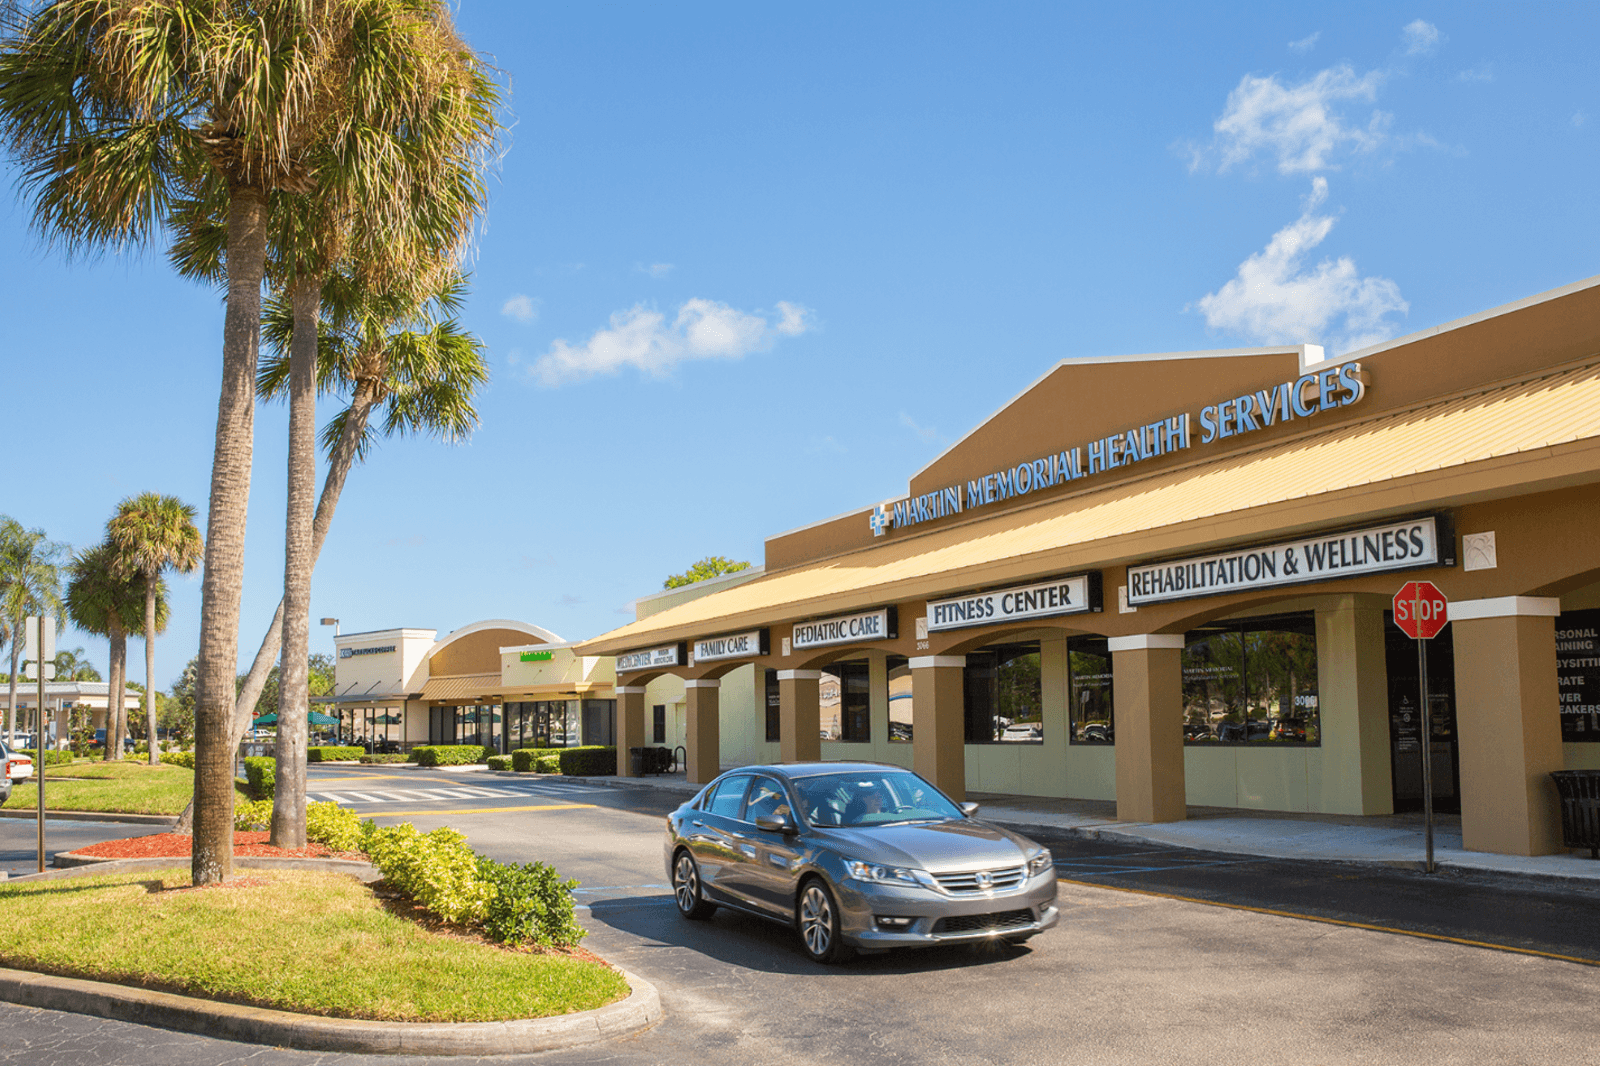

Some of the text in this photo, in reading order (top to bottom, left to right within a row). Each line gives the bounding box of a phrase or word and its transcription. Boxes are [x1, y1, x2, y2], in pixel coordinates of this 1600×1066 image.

[893, 362, 1364, 529] MARTIN MEMORIAL HEALTH SERVICES
[1132, 525, 1424, 597] REHABILITATION & WELLNESS
[933, 584, 1072, 624] FITNESS CENTER
[1397, 599, 1445, 621] STOP
[700, 635, 748, 657] FAMILY CARE
[795, 615, 879, 644] PEDIATRIC CARE
